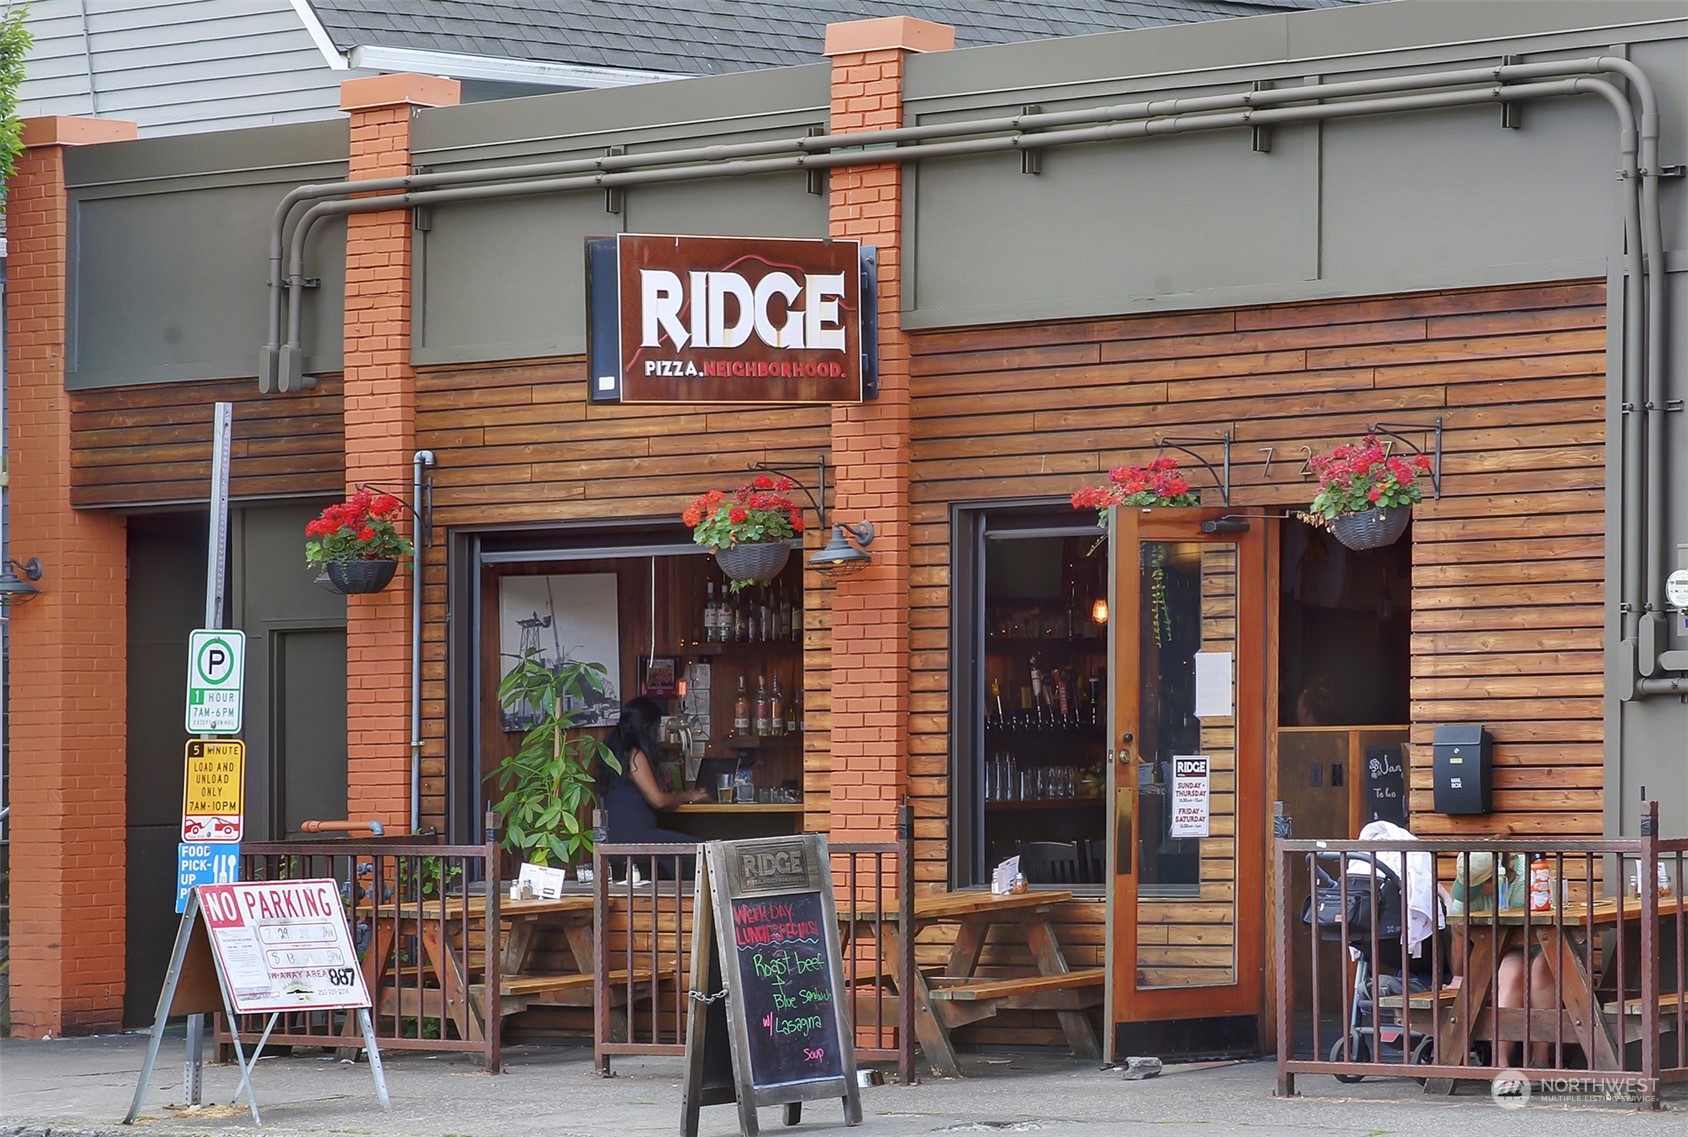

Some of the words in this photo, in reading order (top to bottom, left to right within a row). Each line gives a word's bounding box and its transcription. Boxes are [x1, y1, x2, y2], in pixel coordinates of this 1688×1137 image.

[639, 269, 847, 354] RIDGE
[208, 649, 225, 675] P
[194, 690, 200, 703] 1
[208, 692, 235, 703] HOUR
[193, 707, 235, 717] 7AM-6PM
[193, 745, 200, 756] 5
[207, 746, 239, 755] MINUTE
[194, 762, 213, 772] LOAD
[216, 762, 234, 772] AND
[1177, 761, 1206, 773] RIDGE
[195, 774, 229, 784] UNLOAD
[201, 787, 223, 797] ONLY
[189, 801, 237, 811] 7AM-10PM
[181, 845, 211, 858] FOOD
[181, 859, 212, 872] PICK-
[742, 850, 803, 880] RIDGE
[180, 873, 197, 885] UP
[204, 890, 238, 923] NO
[243, 887, 333, 920] PARKING
[769, 902, 794, 924] DAY
[271, 951, 280, 965] 8
[753, 950, 791, 978] Roast
[794, 951, 825, 975] beef
[306, 970, 328, 979] AREA
[328, 967, 355, 987] 887
[773, 992, 798, 1011] Blue
[775, 1015, 822, 1038] Lasagna
[803, 1048, 825, 1064] Soup
